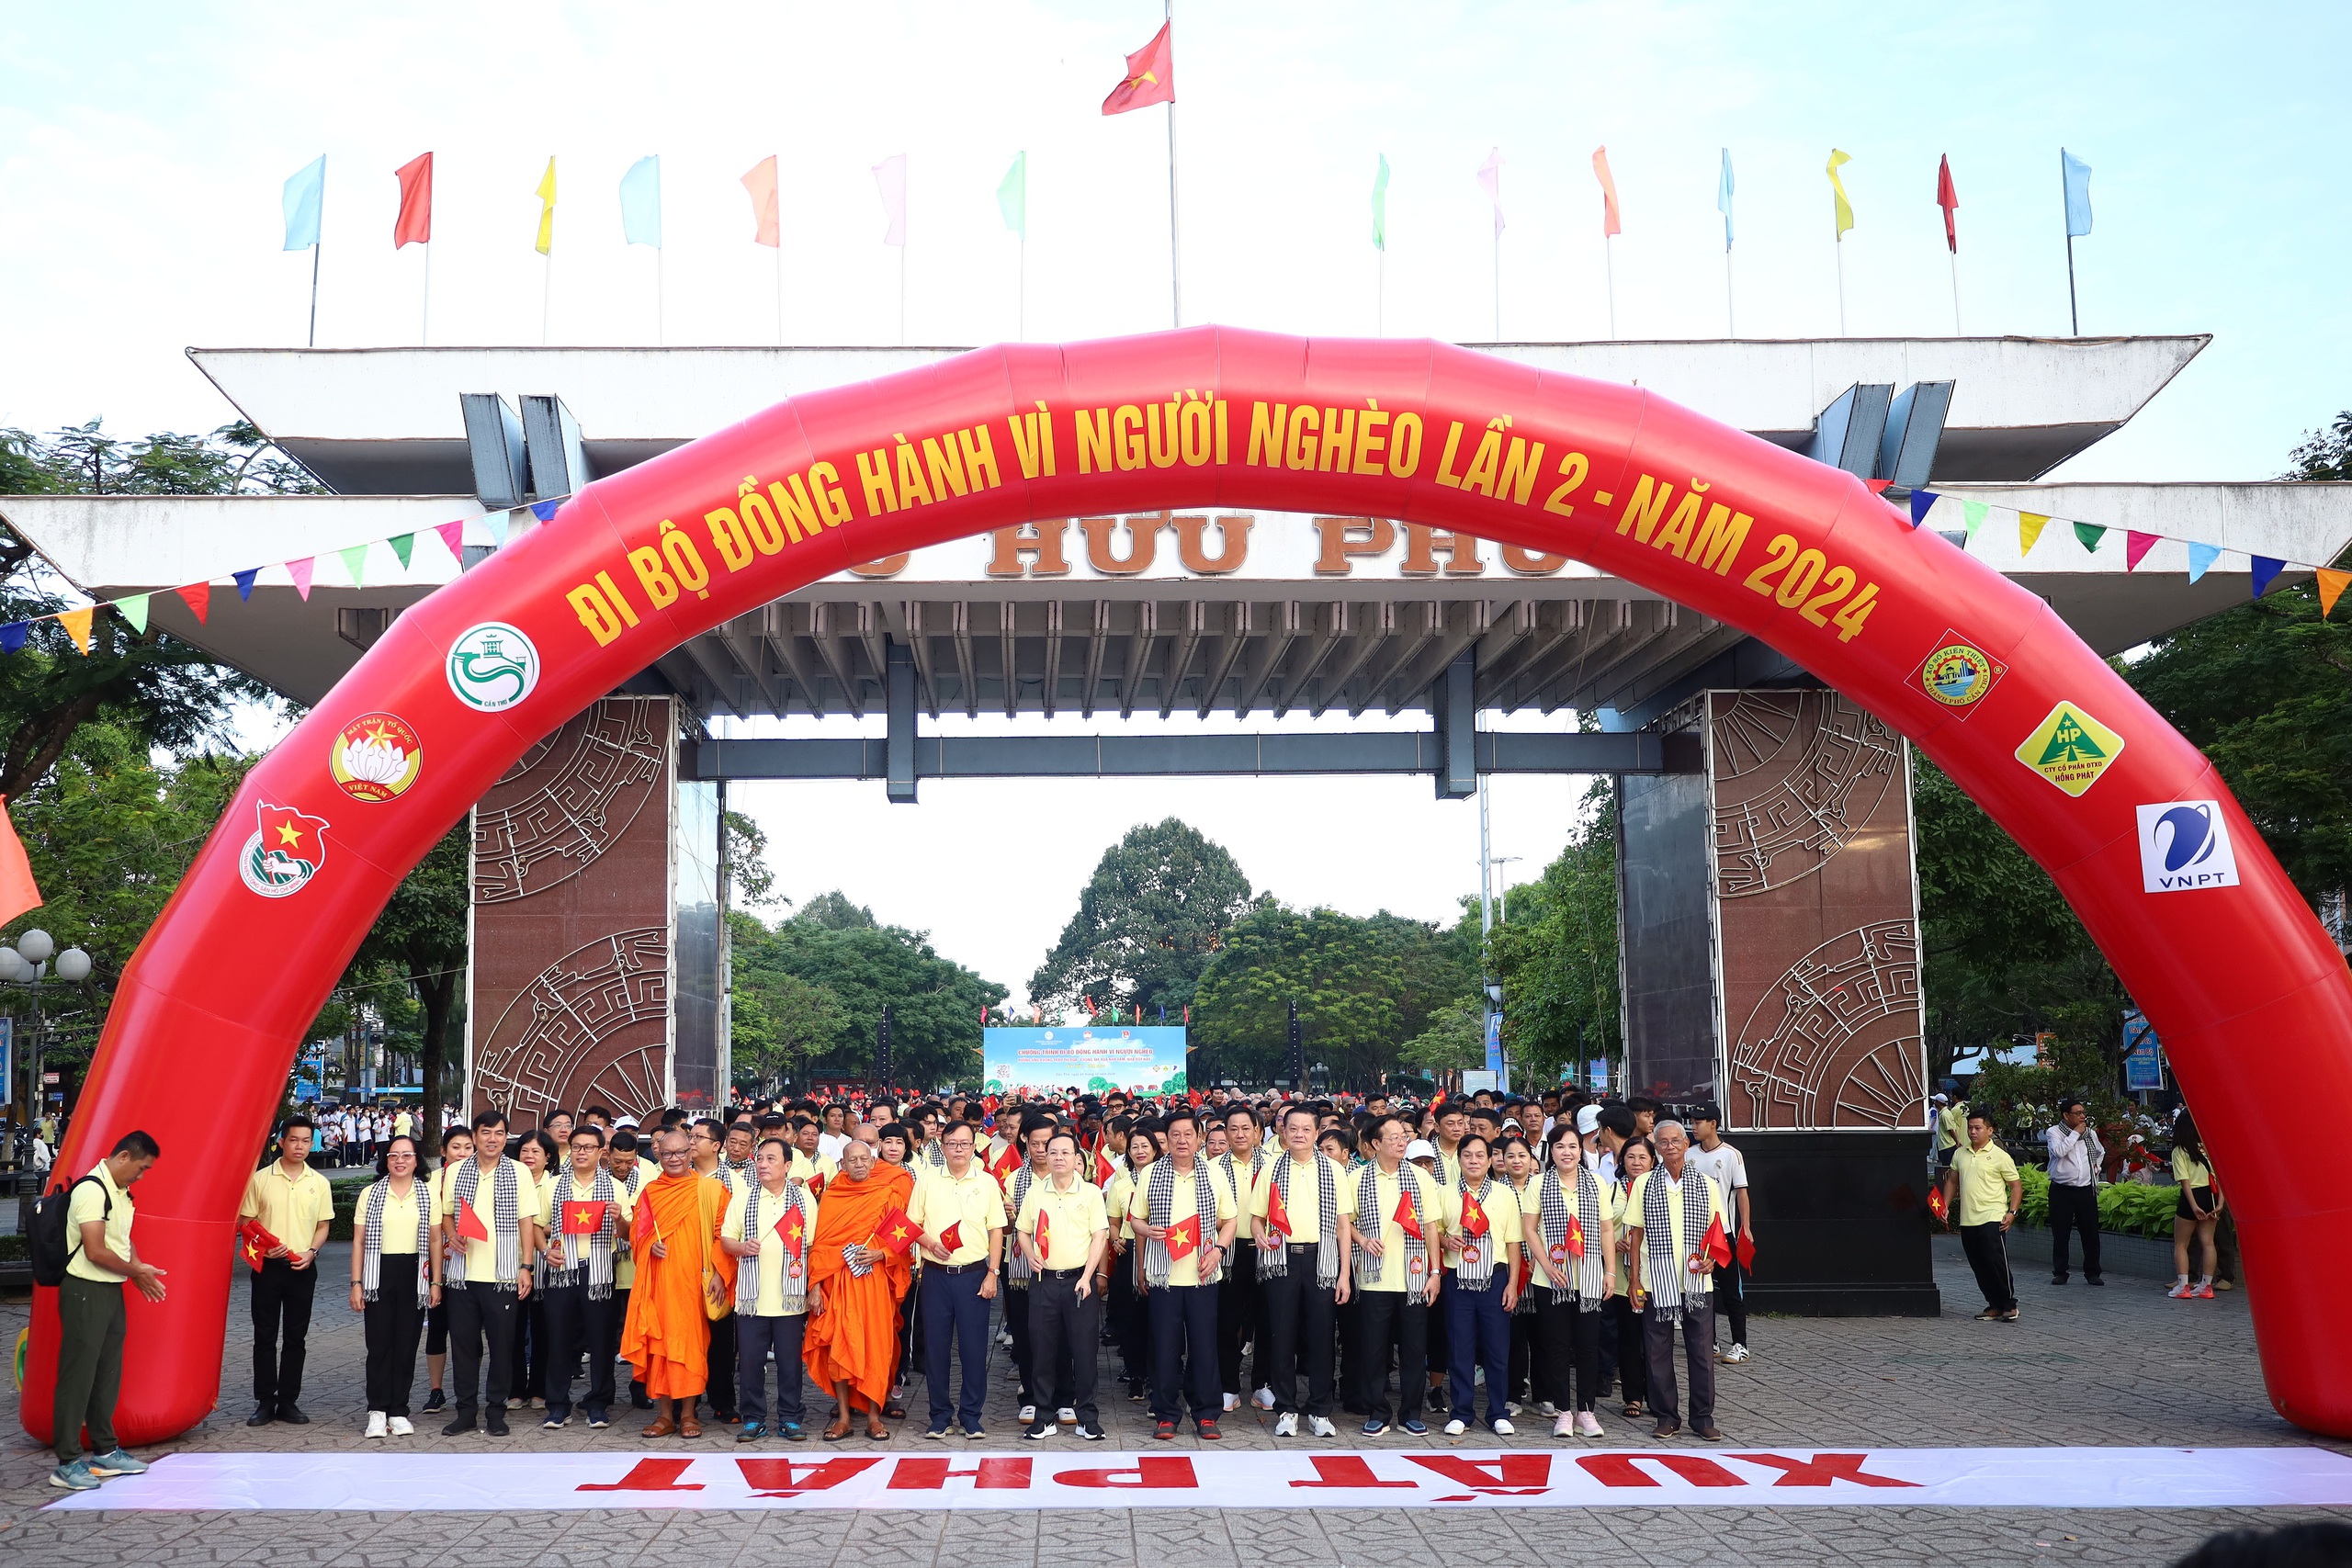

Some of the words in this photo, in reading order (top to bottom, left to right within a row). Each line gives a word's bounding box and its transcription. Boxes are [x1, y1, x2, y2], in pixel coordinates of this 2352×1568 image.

[565, 570, 641, 649] ĐI
[626, 518, 711, 611] BỘ
[703, 473, 854, 574] ĐỒNG
[855, 432, 1001, 518] HÀNH
[1007, 400, 1057, 480] VÌ
[1074, 389, 1229, 476] NGƯỜI
[1246, 398, 1424, 479] NGHÈO
[1434, 413, 1546, 507] LẦN
[1543, 452, 1590, 518] 2
[1615, 473, 1756, 577] NĂM
[1743, 533, 1882, 644] 2024
[2056, 728, 2082, 743] HP
[2076, 771, 2095, 780] PHÁT
[369, 786, 388, 798] NAM
[2158, 873, 2225, 889] VNPT
[575, 1457, 1200, 1498] PHÁT
